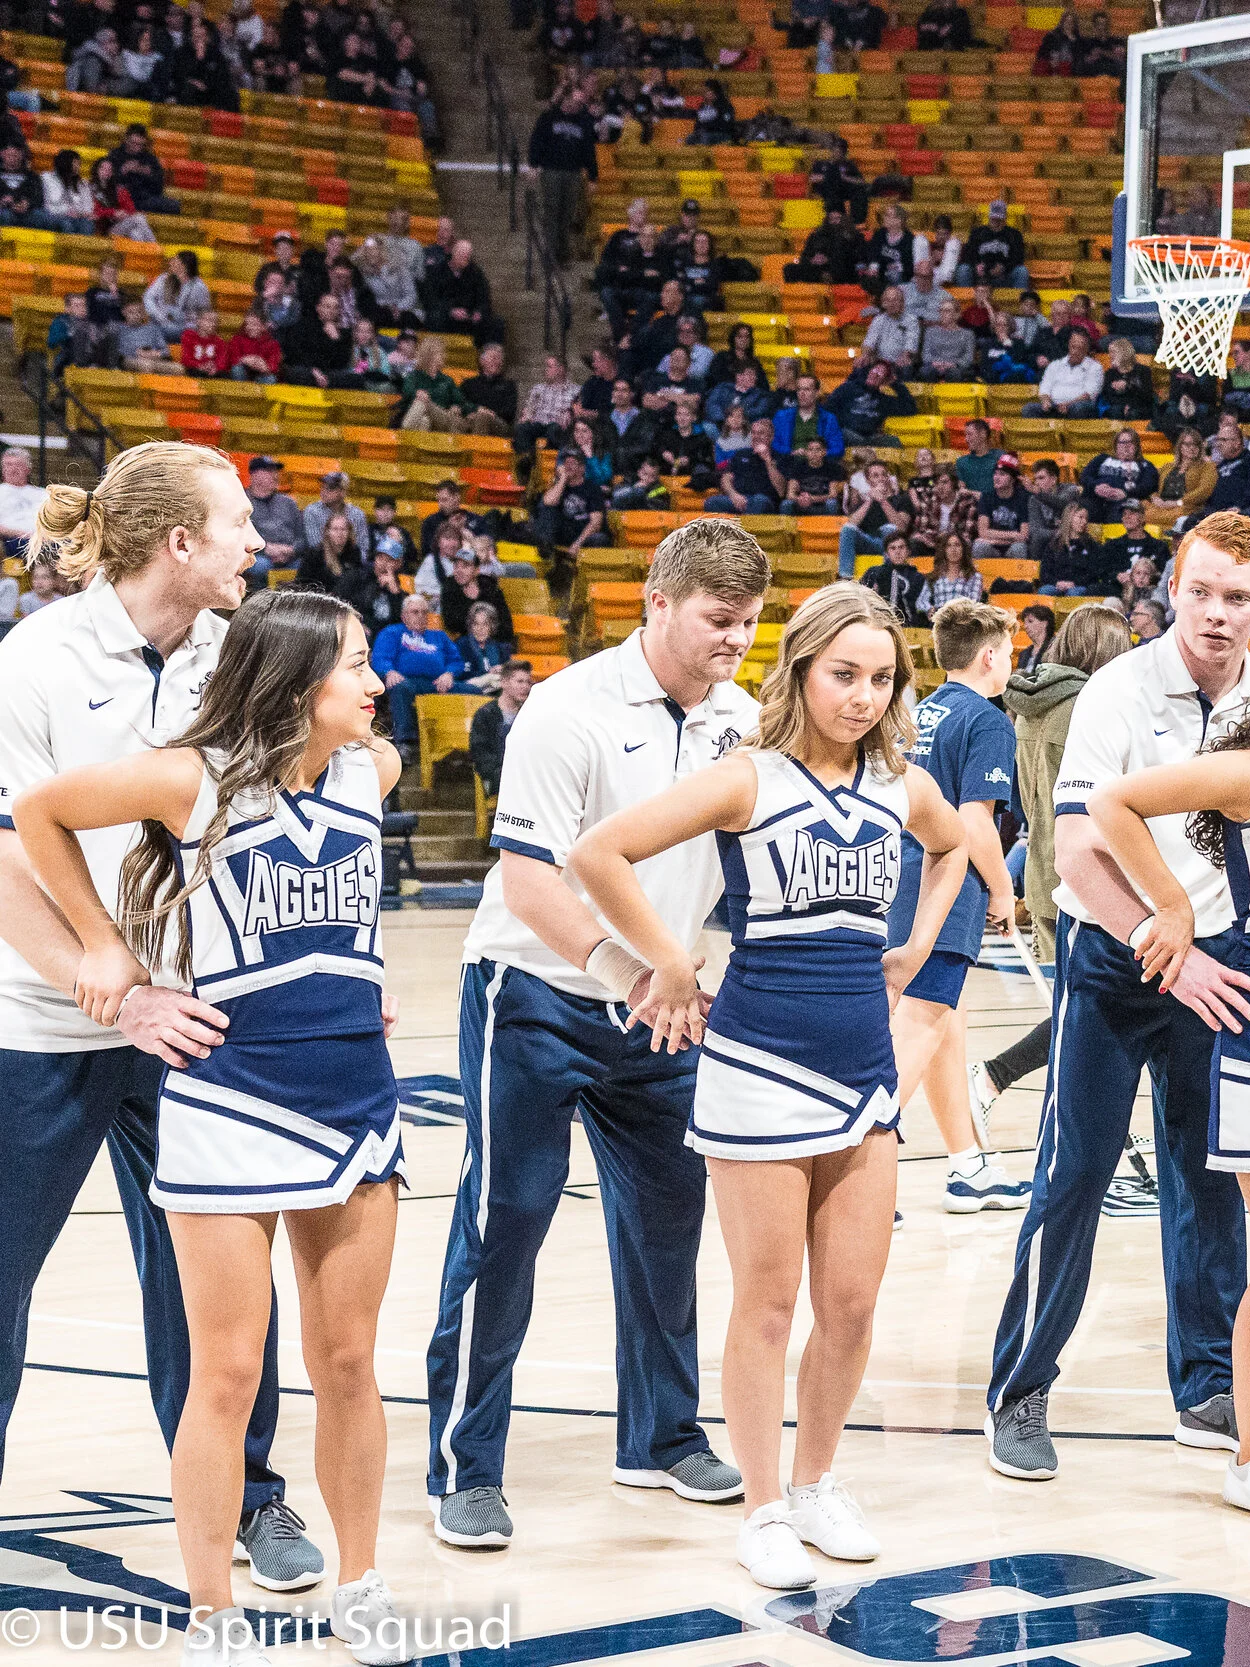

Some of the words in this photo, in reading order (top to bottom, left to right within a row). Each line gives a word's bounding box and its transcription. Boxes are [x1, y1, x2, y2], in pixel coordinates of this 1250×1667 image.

[1071, 779, 1095, 790] STATE
[510, 816, 535, 830] STATE
[785, 829, 899, 905] AGGIES
[242, 842, 378, 938] AGGIES
